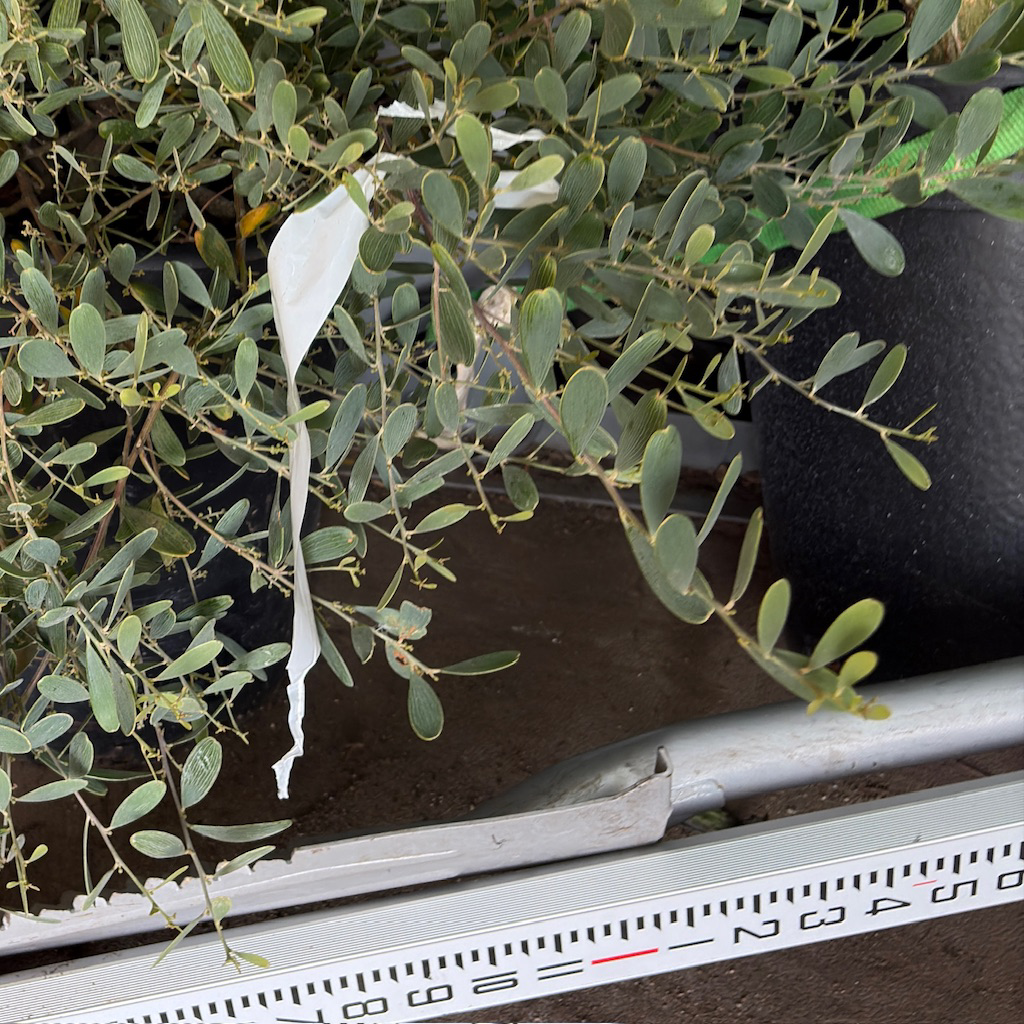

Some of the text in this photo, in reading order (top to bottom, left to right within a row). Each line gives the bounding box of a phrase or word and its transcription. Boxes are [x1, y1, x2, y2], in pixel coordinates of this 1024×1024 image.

[931, 879, 978, 904] 5
[799, 906, 846, 931] 3
[865, 897, 912, 917] 4
[733, 918, 780, 944] 2
[668, 937, 715, 950] 1
[537, 959, 584, 981] 11
[471, 970, 519, 995] 10
[407, 984, 454, 1008] 9
[276, 1009, 325, 1024] 7
[342, 997, 389, 1020] 8
